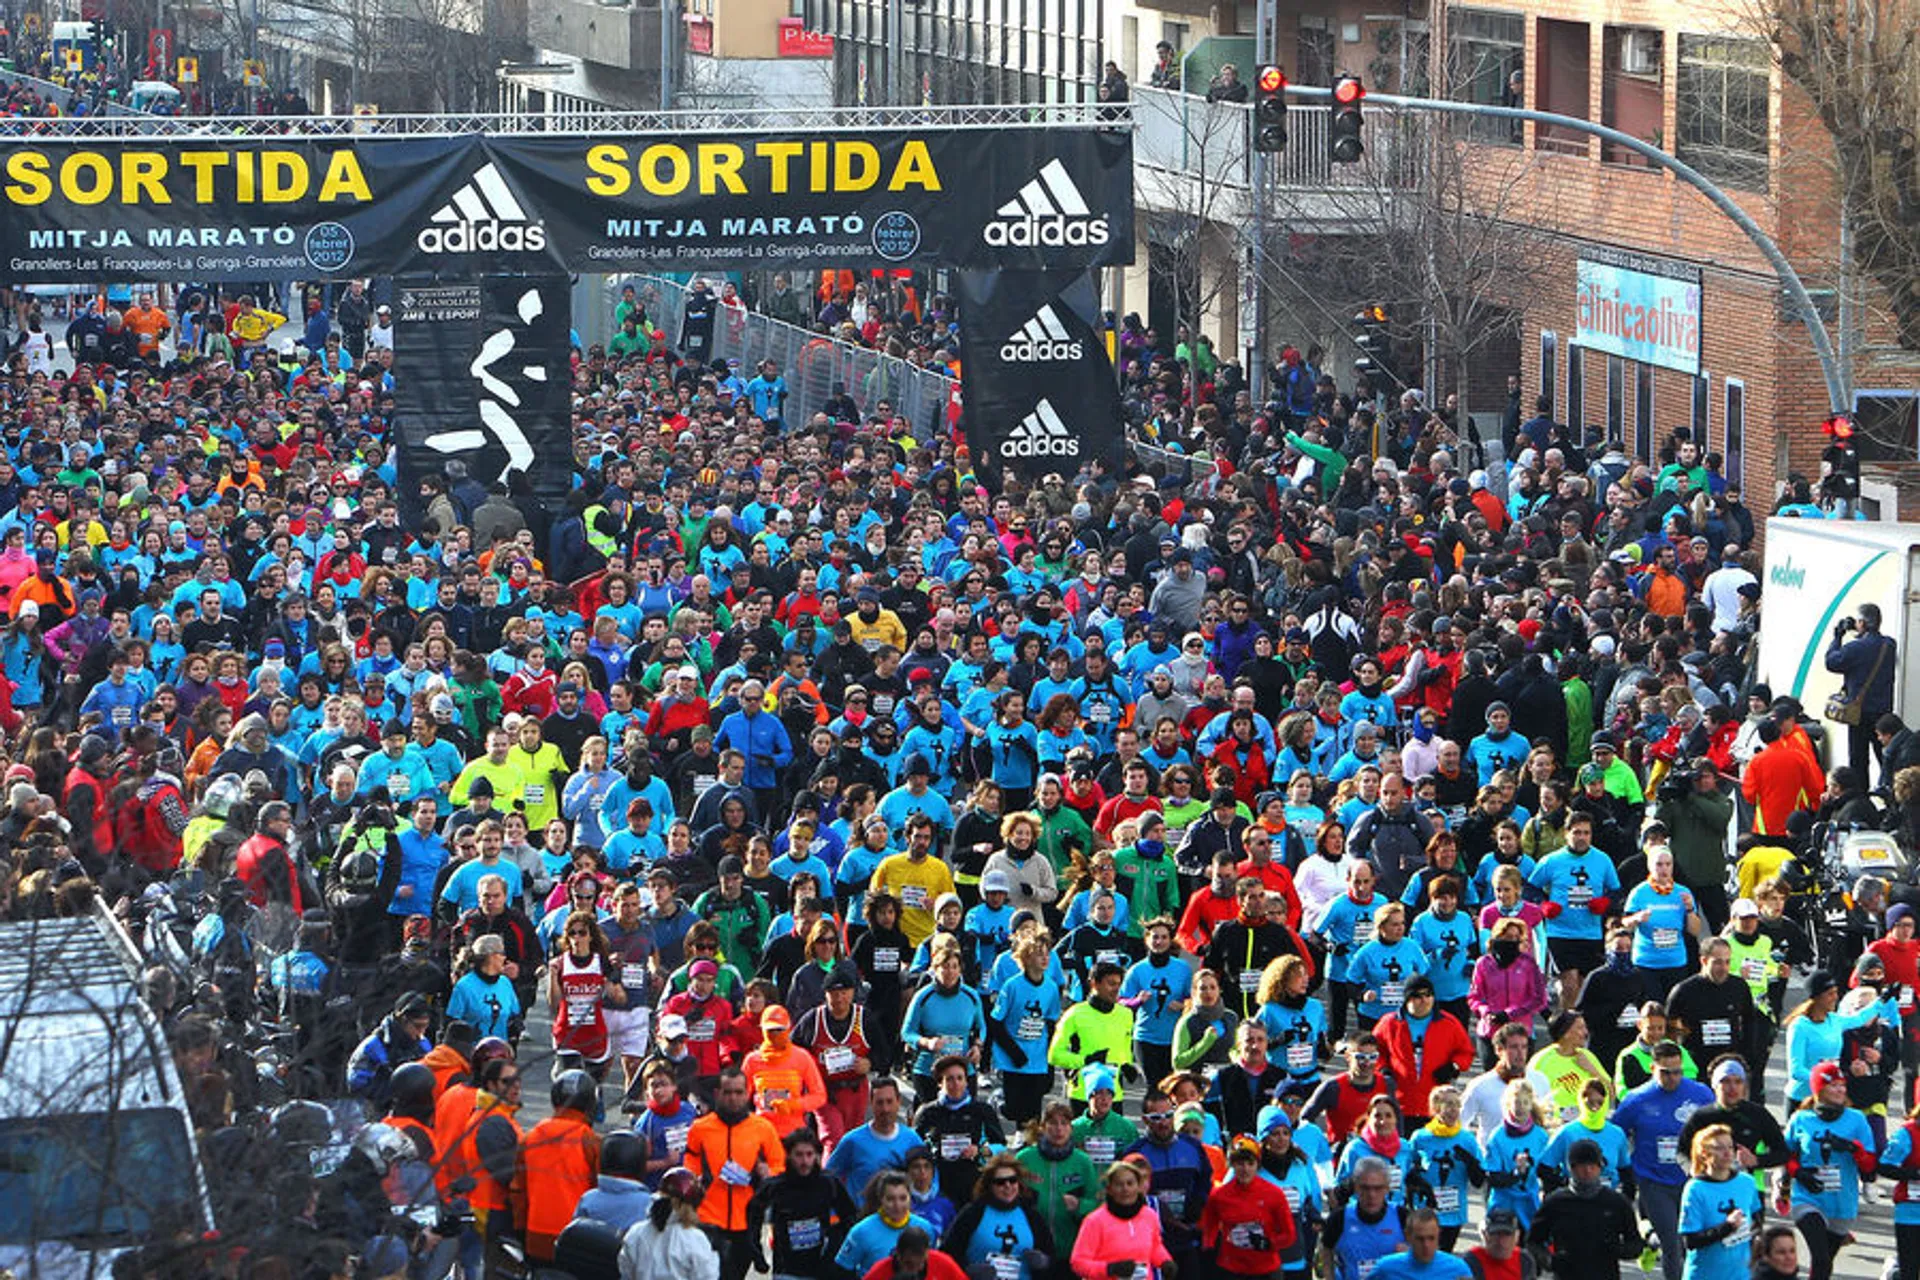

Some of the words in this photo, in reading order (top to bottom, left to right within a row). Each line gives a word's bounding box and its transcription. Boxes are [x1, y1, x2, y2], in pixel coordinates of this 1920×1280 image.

[5, 150, 373, 206] SORTIDA
[586, 140, 942, 196] SORTIDA
[29, 229, 133, 249] MITJA
[147, 222, 296, 247] MARATÓ
[418, 219, 546, 253] adidas
[607, 219, 707, 237] MITJA
[721, 211, 864, 235] MARATÓ
[983, 213, 1109, 247] adidas
[309, 238, 349, 250] febrer
[313, 250, 346, 262] 2012
[880, 241, 911, 252] 2012
[1000, 340, 1083, 362] adidas
[1000, 434, 1079, 457] adidas
